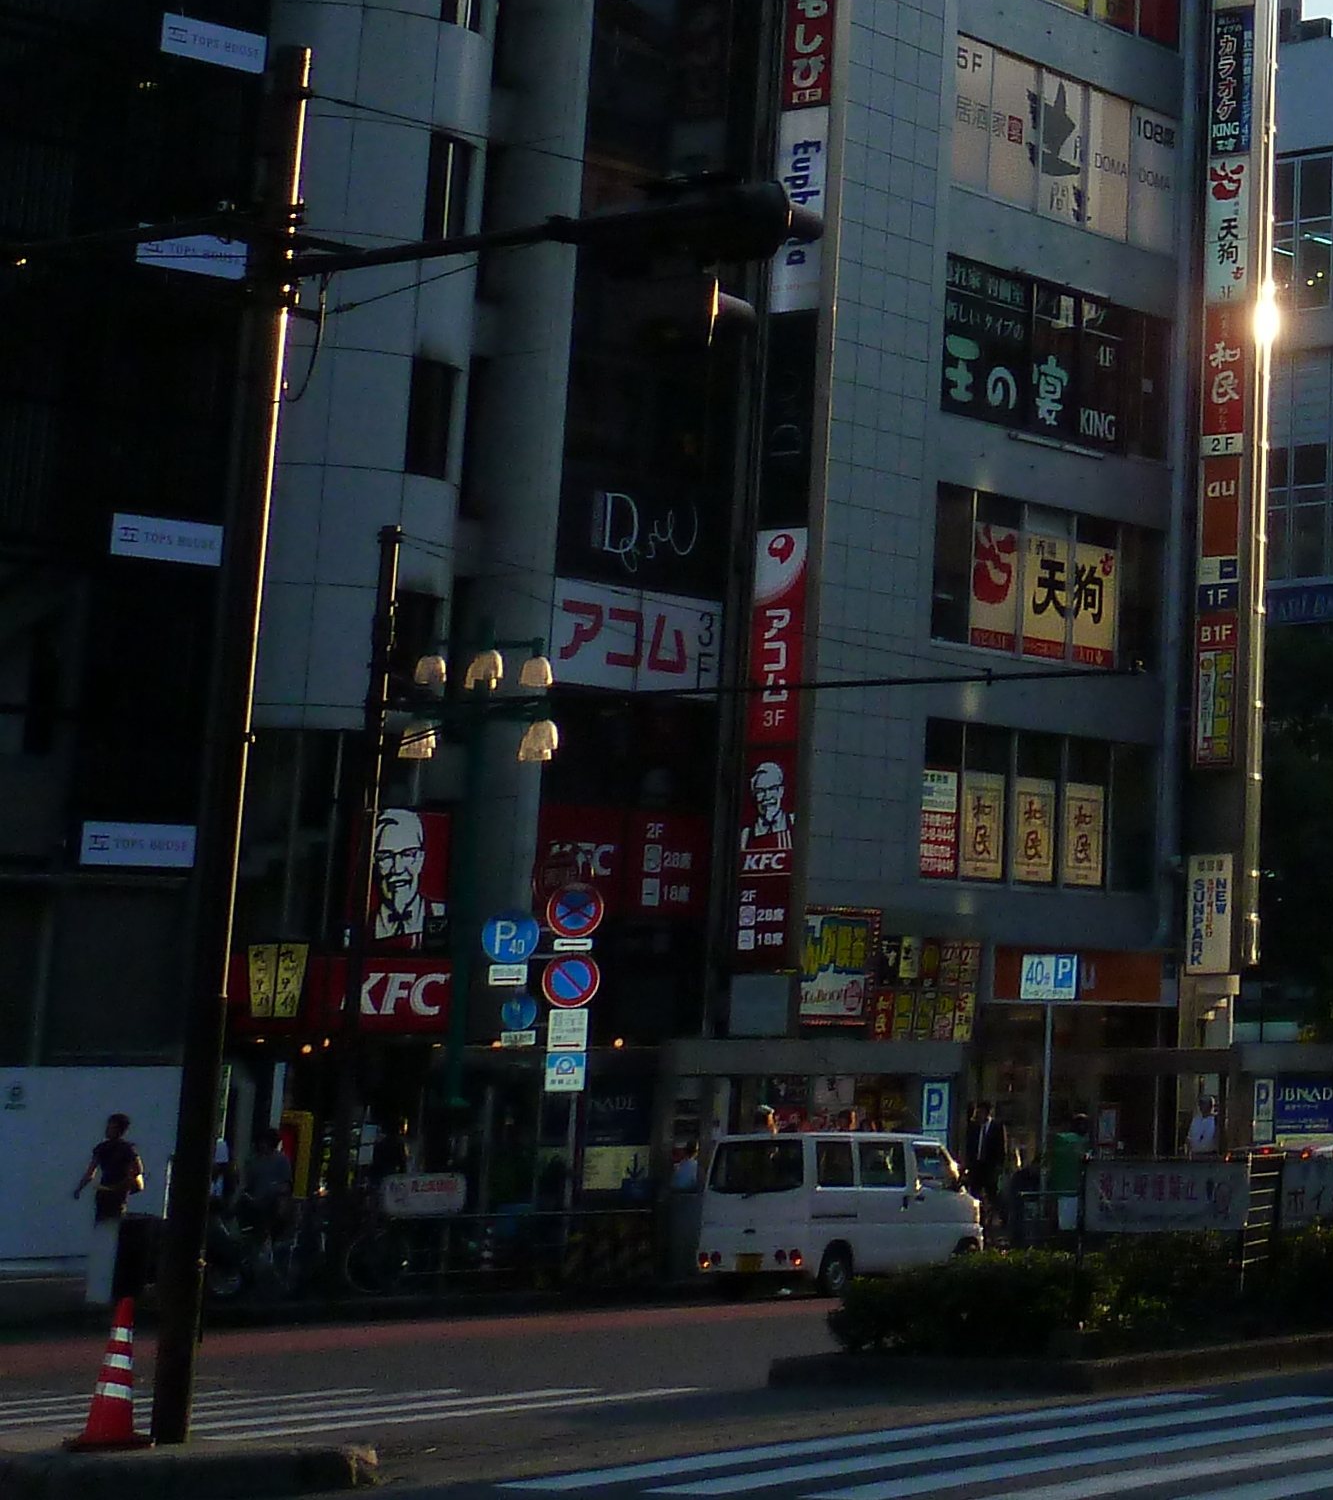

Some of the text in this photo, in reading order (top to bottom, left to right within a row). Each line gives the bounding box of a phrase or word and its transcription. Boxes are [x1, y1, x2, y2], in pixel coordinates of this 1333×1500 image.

[957, 46, 982, 73] 5F
[1216, 35, 1237, 122] カラオケ
[1212, 121, 1240, 137] KING
[1217, 218, 1239, 265] 天狗
[1209, 342, 1241, 404] 和民
[1079, 407, 1117, 442] KING
[1211, 436, 1235, 451] 2F
[1207, 479, 1235, 497] au
[1032, 557, 1105, 625] 天狗
[1206, 587, 1229, 604] 1F
[560, 599, 687, 673] アコム
[696, 611, 717, 681] 3F
[1200, 625, 1233, 642] B1F
[762, 608, 792, 703] アコム
[762, 709, 786, 729] 3F
[646, 822, 665, 840] 2F
[743, 853, 787, 871] KFC
[741, 889, 757, 903] 2F
[1215, 878, 1227, 915] NEW
[494, 920, 517, 956] P
[1191, 879, 1205, 966] SUNPARK
[1057, 958, 1072, 981] P
[360, 972, 451, 1017] KFC
